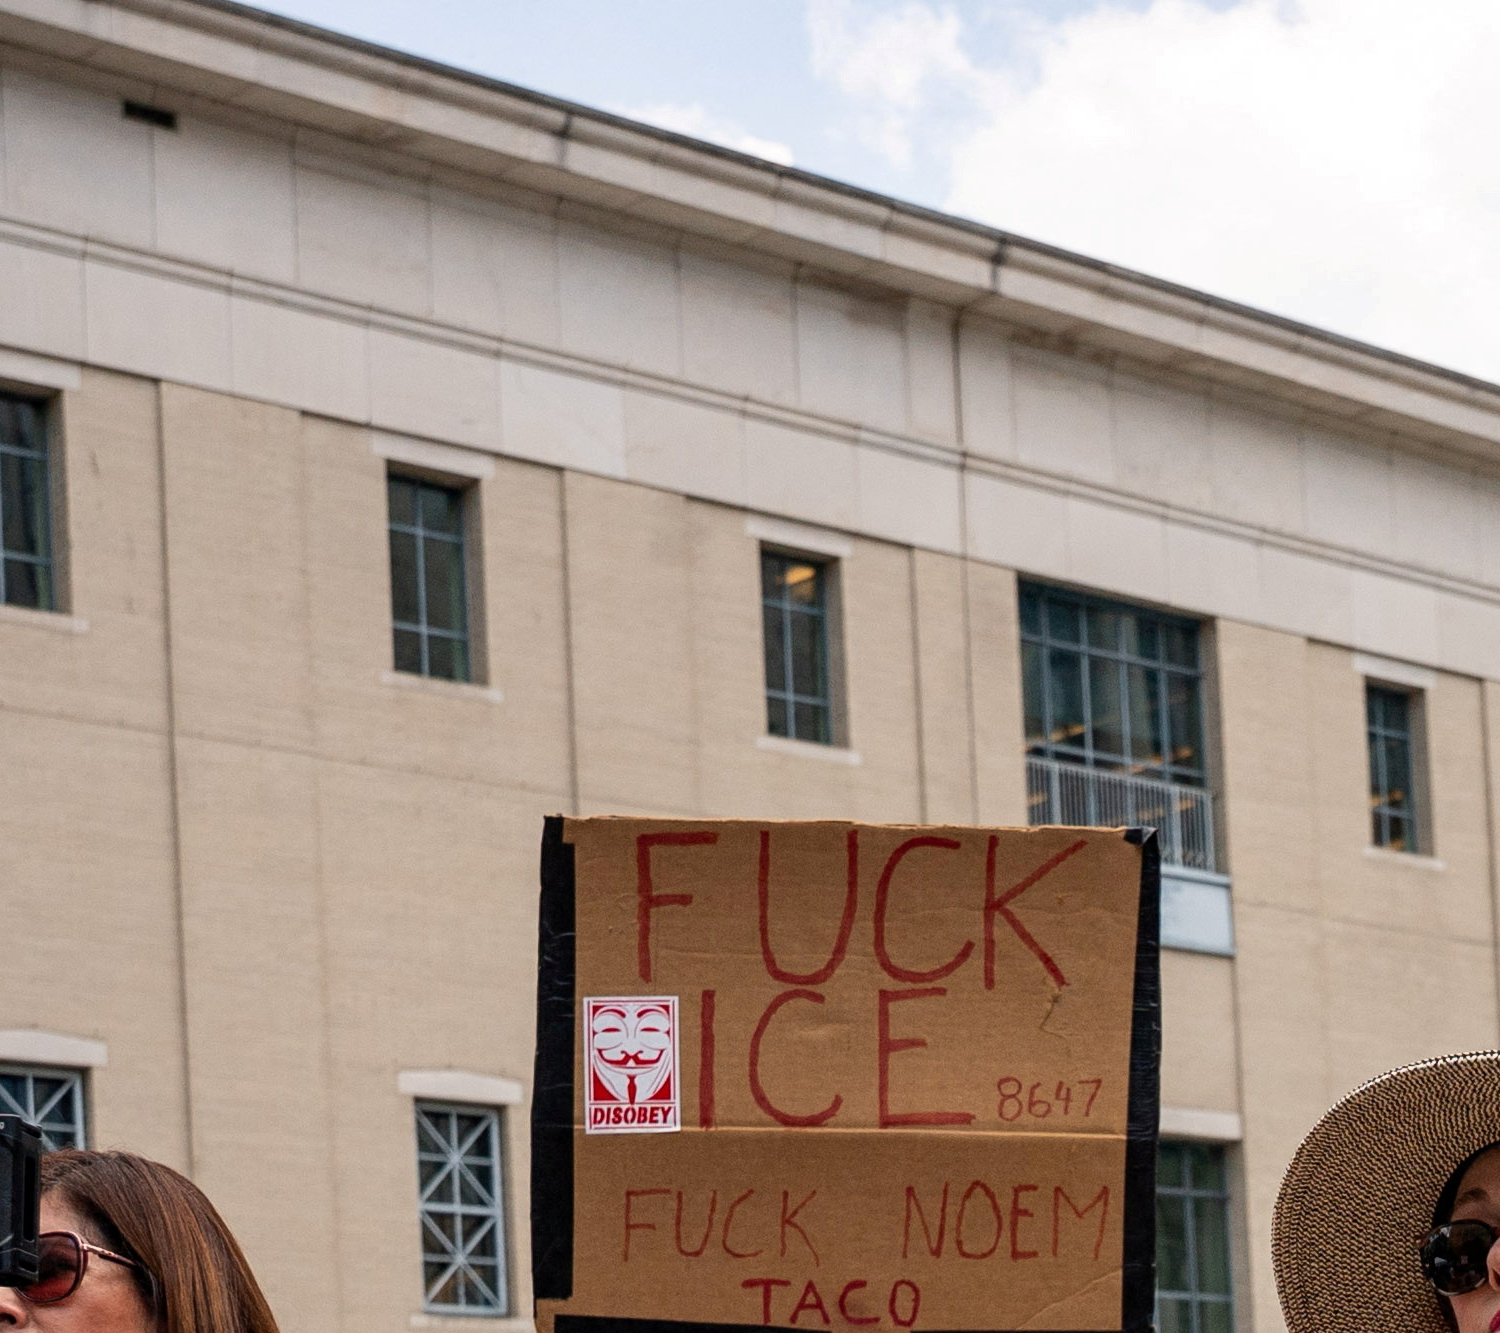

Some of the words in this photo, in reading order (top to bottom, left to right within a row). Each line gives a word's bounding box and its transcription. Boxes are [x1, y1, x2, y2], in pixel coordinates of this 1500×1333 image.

[637, 829, 1088, 991] FUCK
[700, 987, 976, 1131] ICE
[593, 1106, 672, 1125] DISOBEY
[996, 1076, 1103, 1122] 8647
[621, 1187, 820, 1267] FUCK
[902, 1179, 1110, 1264] NOEM
[740, 1277, 922, 1328] TACO
